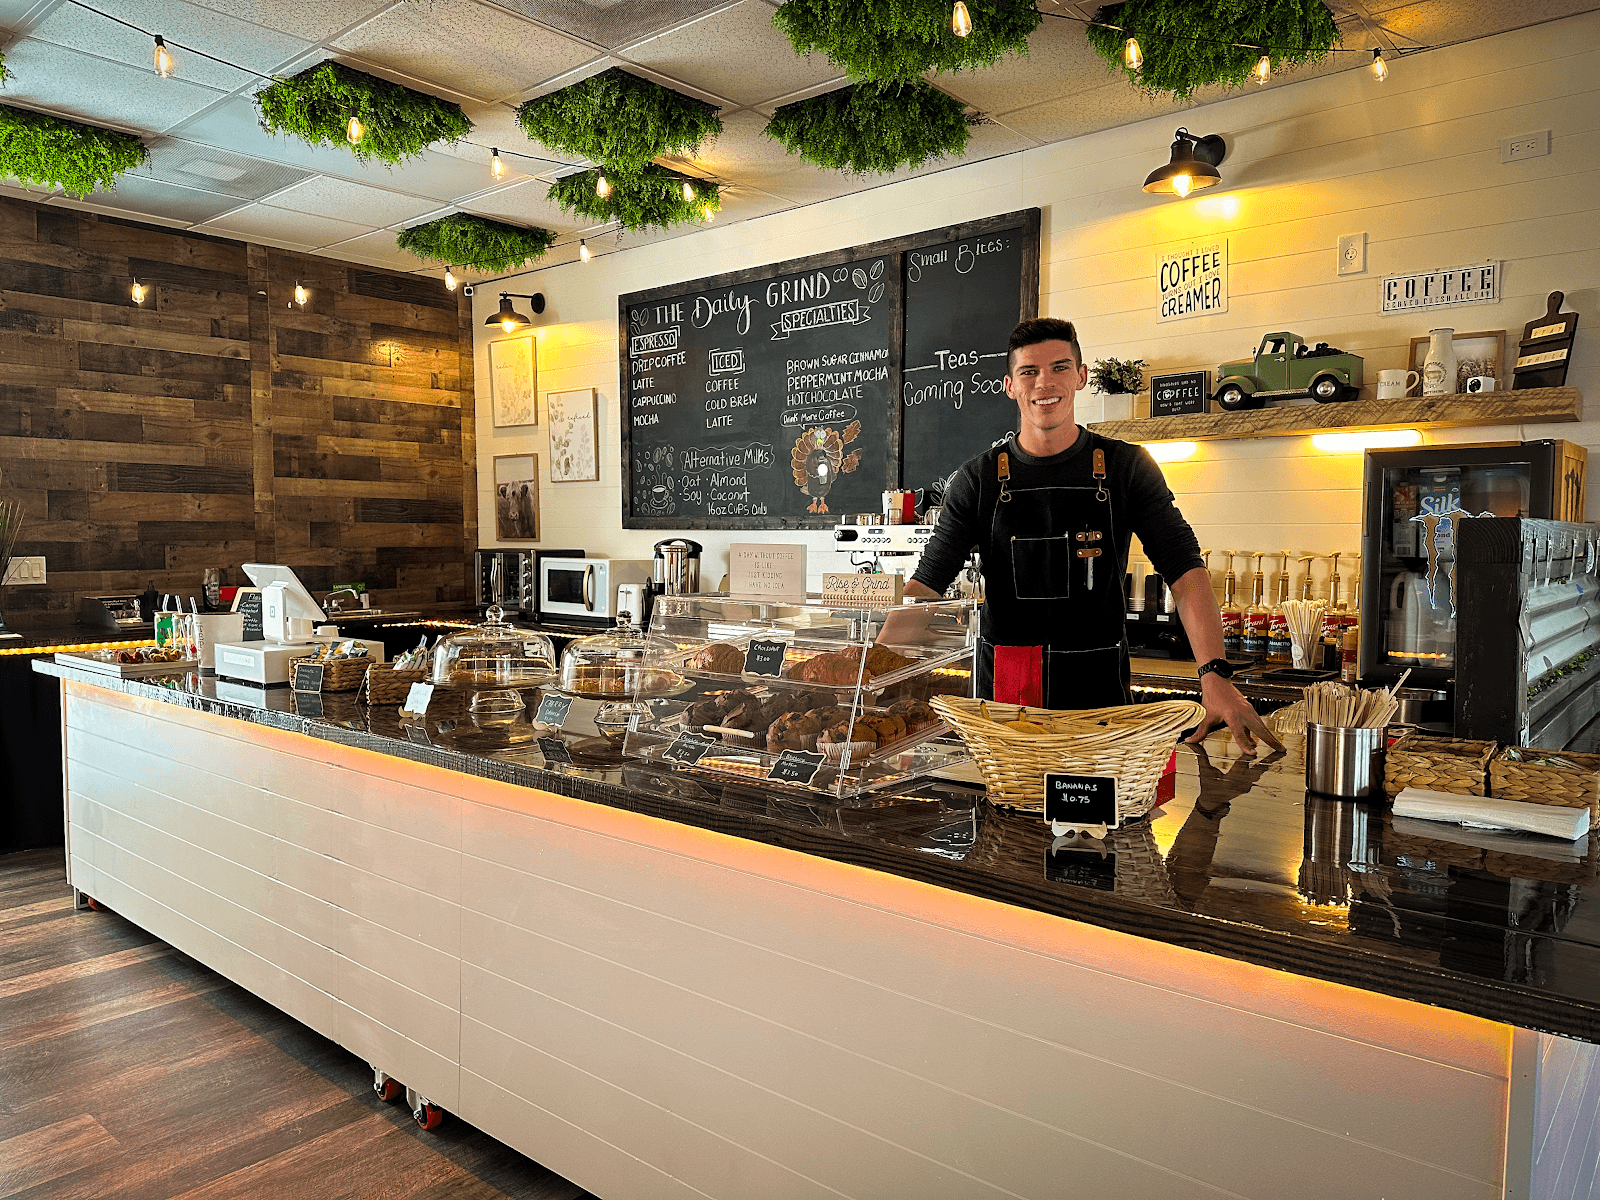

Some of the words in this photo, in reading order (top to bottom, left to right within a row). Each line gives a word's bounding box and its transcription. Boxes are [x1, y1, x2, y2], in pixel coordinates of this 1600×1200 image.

[908, 250, 948, 283] Small
[955, 239, 1010, 274] Bites:
[1167, 249, 1193, 261] THOUGHT
[1201, 244, 1220, 253] LOVED
[1160, 251, 1220, 293] COFFEE
[1162, 286, 1182, 301] TURNS
[1184, 279, 1196, 291] OUT
[1205, 268, 1220, 281] LOVE
[1387, 269, 1491, 301] COFFEE
[652, 302, 685, 324] THE
[691, 290, 760, 335] Daily
[766, 271, 831, 308] GRIND
[1161, 277, 1221, 317] CREAMER
[1386, 299, 1419, 308] SERVED
[1454, 292, 1470, 300] ALL
[783, 302, 855, 331] SPECIALTIES
[634, 333, 675, 352] ESPRESSO
[632, 358, 654, 376] DRIP
[654, 351, 687, 368] COFFEE
[715, 353, 739, 369] ICED
[786, 358, 820, 375] BROWN
[821, 354, 849, 368] SUGAR
[934, 349, 979, 371] Teas
[632, 377, 655, 391] LATTE
[705, 378, 740, 393] COFFEE
[787, 371, 853, 393] PEPPERMINT
[853, 365, 889, 383] MOCHA
[632, 393, 677, 408] CAPPUCCINO
[705, 398, 728, 412] COLD
[729, 392, 758, 408] BREW
[786, 392, 805, 406] HOT
[805, 384, 864, 405] CHOCOLATE
[903, 378, 963, 410] Coming
[1156, 386, 1200, 401] COFFEE
[634, 413, 659, 427] MOCHA
[706, 414, 734, 428] LATTE
[818, 409, 845, 421] Coffee
[683, 450, 741, 470] Alternative
[743, 448, 770, 465] Milks
[681, 475, 701, 488] Oat
[709, 471, 747, 487] Almond
[682, 487, 702, 506] Soy
[709, 486, 751, 503] Coconut
[1419, 493, 1460, 515] Silk
[708, 502, 727, 516] 16oz
[743, 551, 754, 559] DAY
[754, 551, 776, 560] WITHOUT
[776, 551, 794, 560] COFFEE
[754, 561, 761, 569] IS
[761, 562, 773, 570] LIKE
[748, 571, 759, 579] JUST
[759, 571, 783, 580] KIDDING
[825, 575, 849, 591] Rise
[851, 577, 860, 589] &
[861, 575, 890, 591] Grind
[749, 581, 762, 589] HAVE
[772, 582, 785, 590] IDEA
[1244, 616, 1265, 630] Torani
[1269, 618, 1289, 633] Toran
[1055, 780, 1098, 791] BANANAS
[1061, 793, 1090, 804] $0.75
